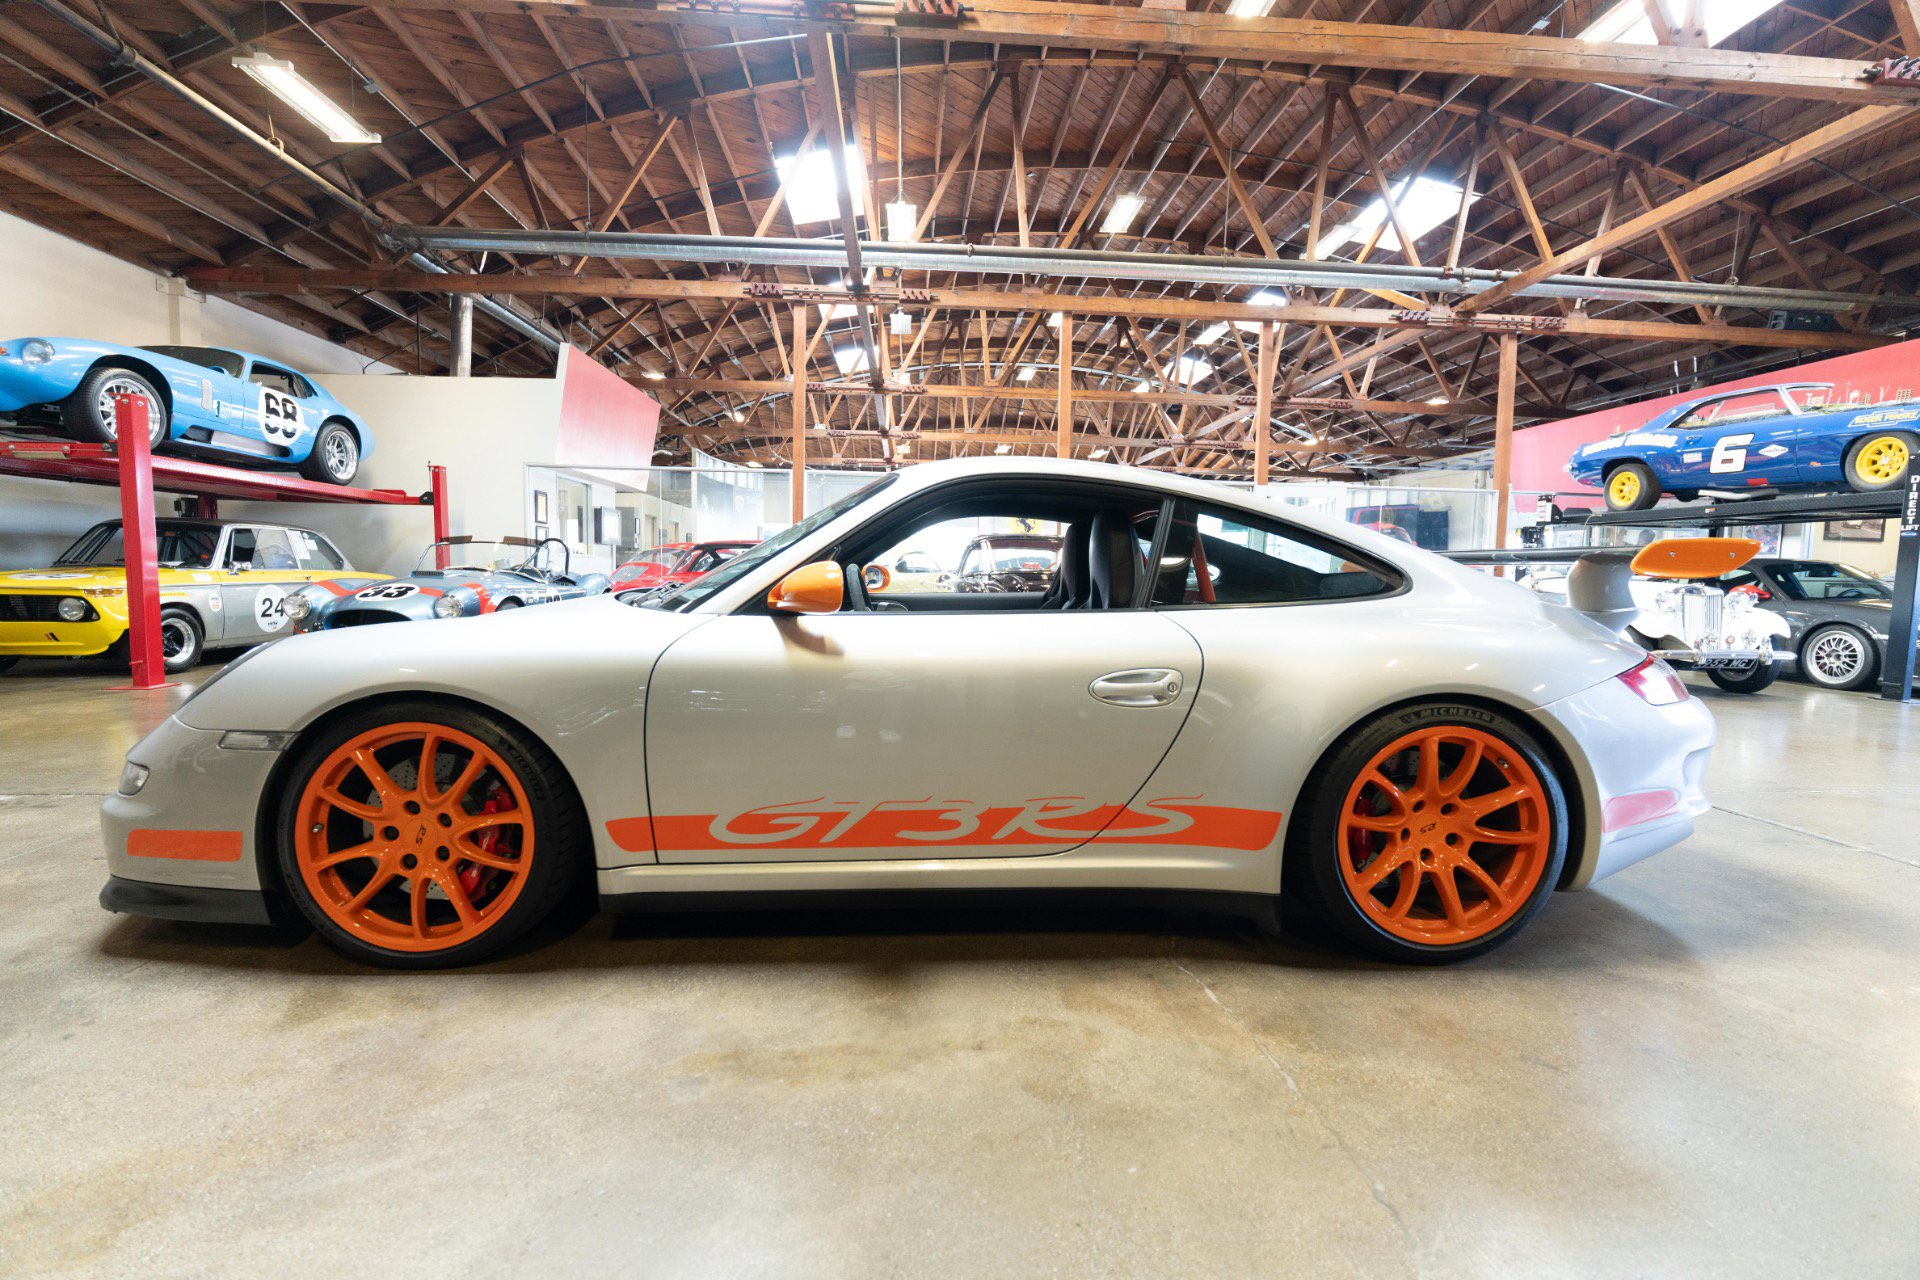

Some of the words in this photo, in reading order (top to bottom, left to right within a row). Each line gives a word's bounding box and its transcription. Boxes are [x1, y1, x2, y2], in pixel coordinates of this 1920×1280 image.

[1709, 433, 1755, 474] 6
[1906, 475, 1920, 525] DIRECT
[358, 586, 416, 599] 33
[260, 597, 285, 618] 24
[1730, 658, 1749, 668] MG
[1421, 706, 1493, 721] MICHELIN
